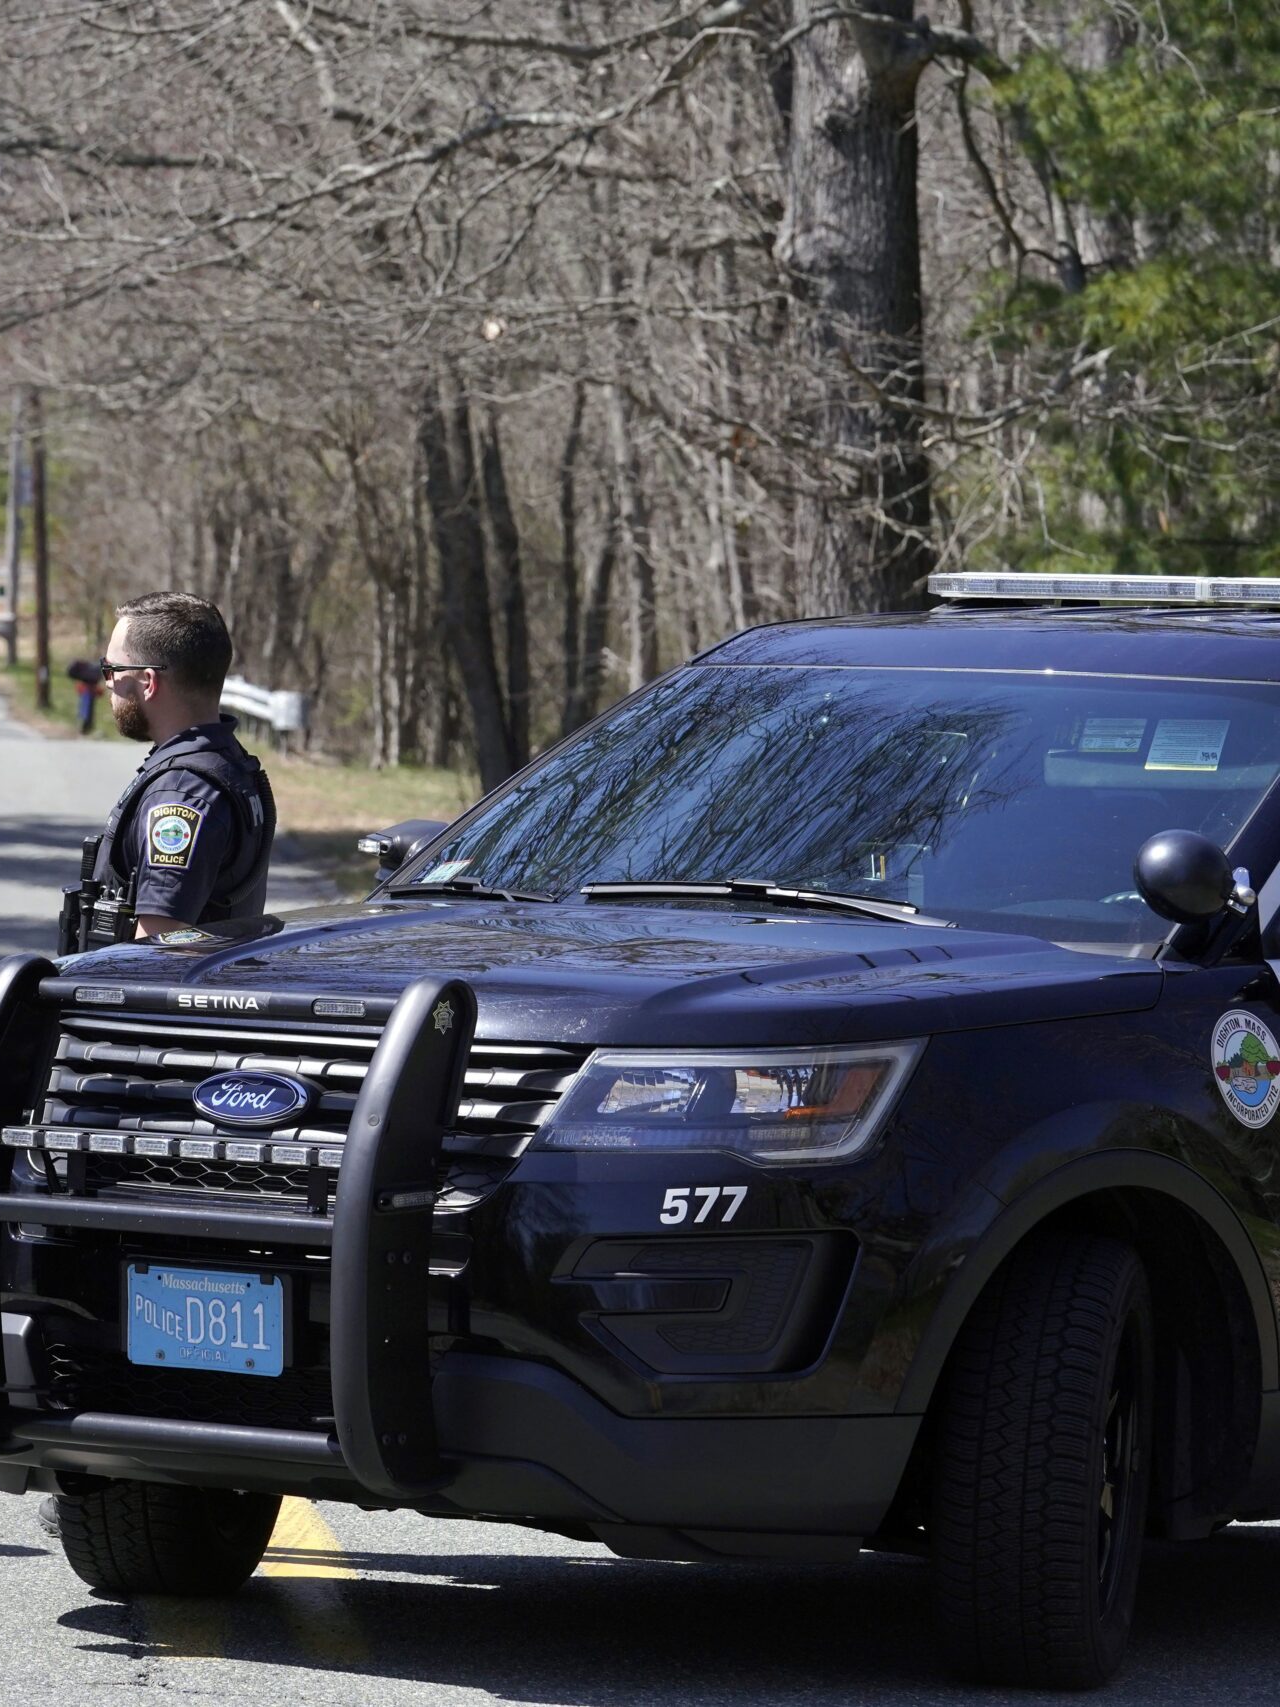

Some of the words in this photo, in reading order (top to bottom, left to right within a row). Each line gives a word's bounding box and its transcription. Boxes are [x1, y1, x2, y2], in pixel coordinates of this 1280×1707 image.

[153, 807, 196, 820] DIGHTON
[153, 854, 184, 864] POLICE
[178, 994, 260, 1011] SETINA
[211, 1077, 277, 1110] Ford
[1226, 1089, 1269, 1121] INCORPORATED
[1267, 1085, 1279, 1107] 1712
[660, 1185, 748, 1225] 577
[162, 1272, 246, 1295] Massachusetts
[135, 1293, 184, 1342] POLICE
[186, 1296, 270, 1350] D811
